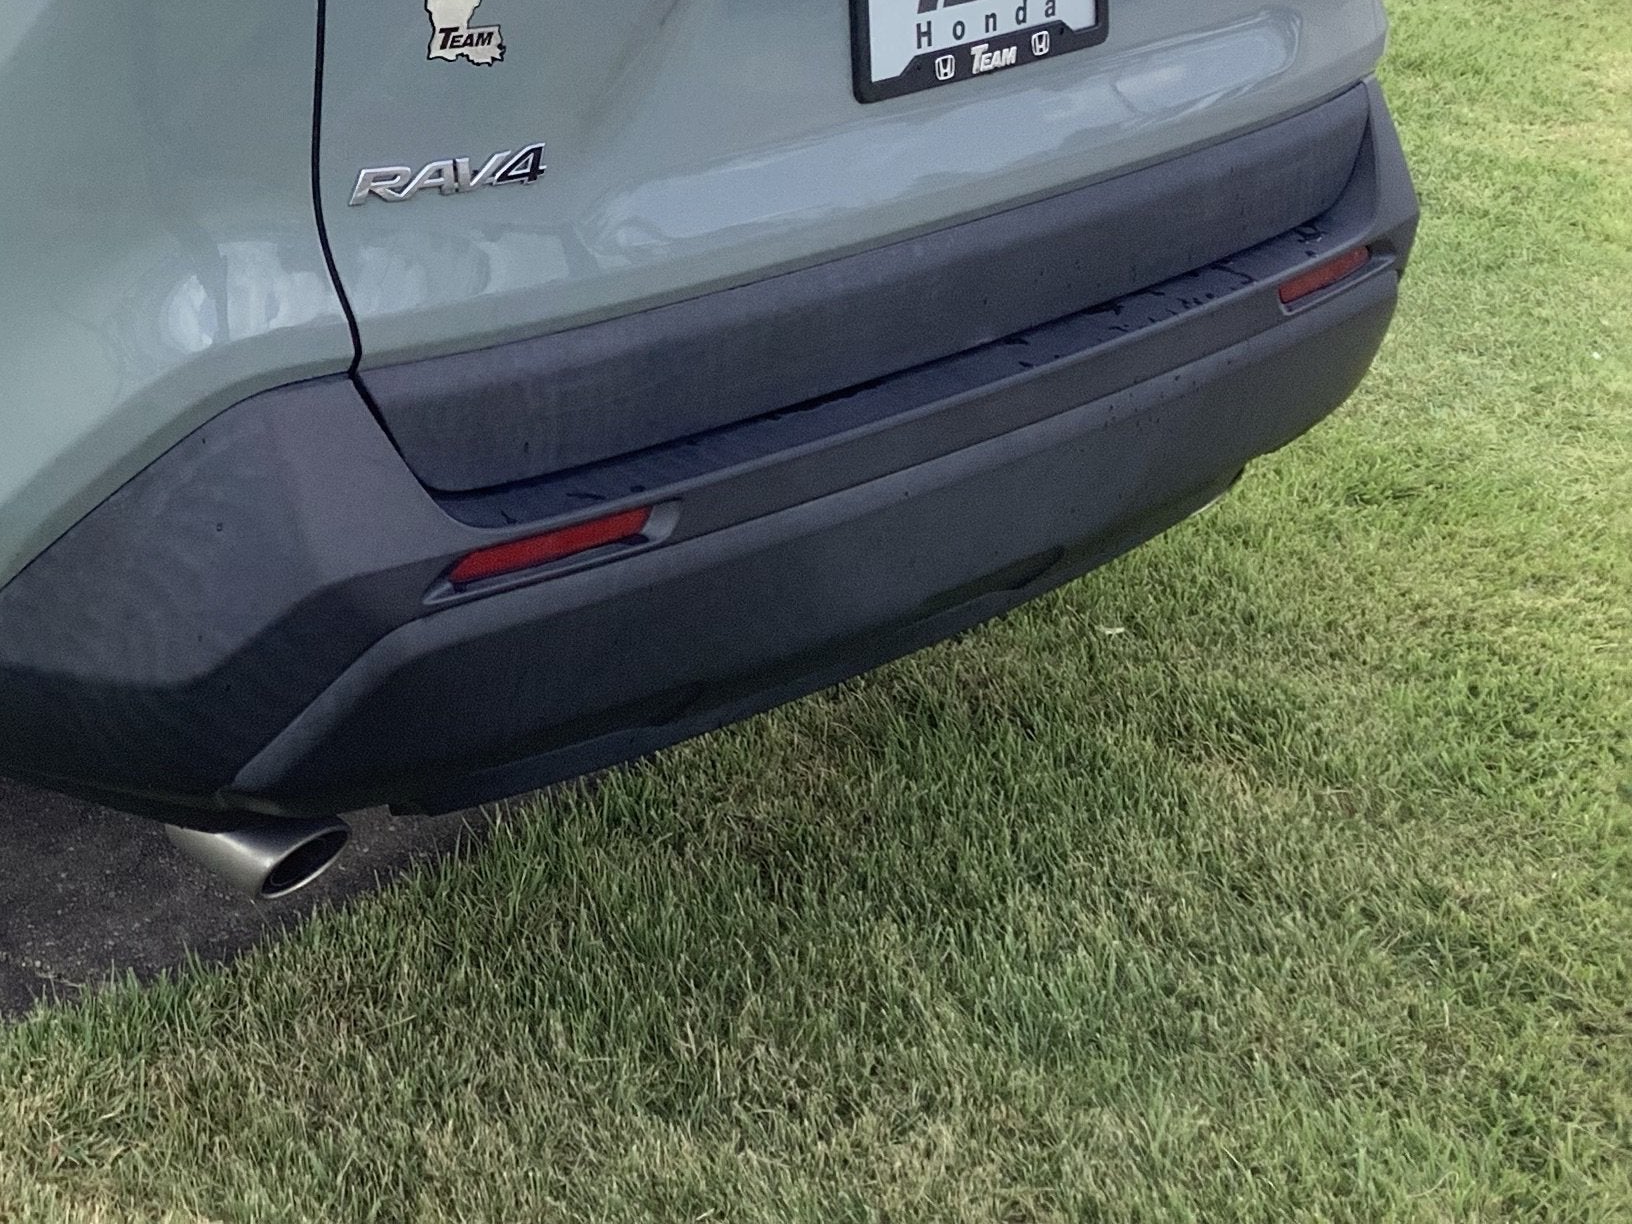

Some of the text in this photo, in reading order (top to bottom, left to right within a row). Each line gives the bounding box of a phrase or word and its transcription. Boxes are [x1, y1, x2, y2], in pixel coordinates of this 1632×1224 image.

[438, 27, 494, 50] TEAM
[970, 43, 1017, 74] TEAM
[348, 142, 547, 206] RAV4
